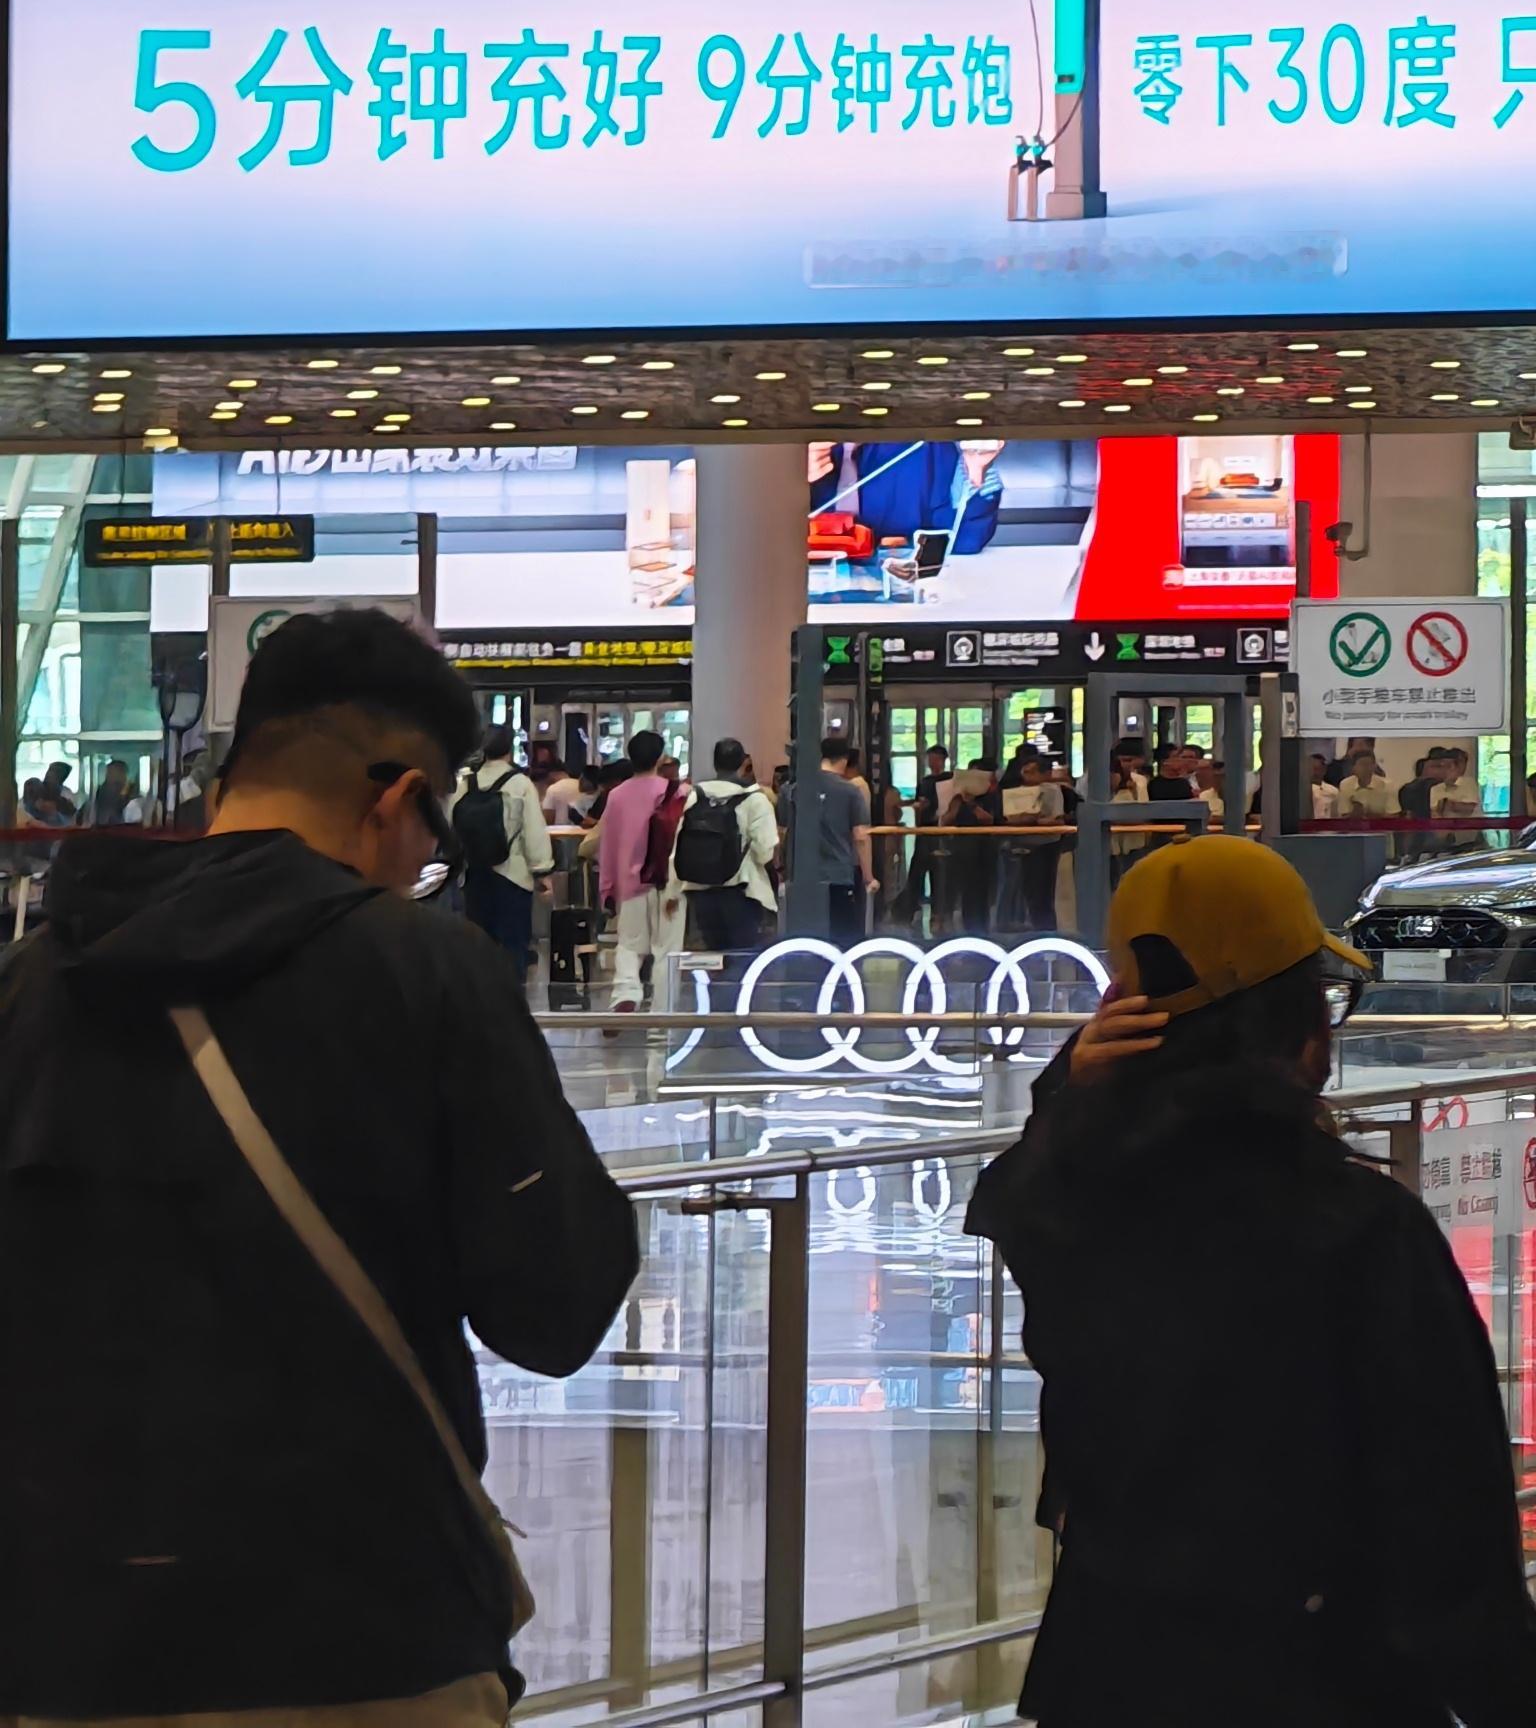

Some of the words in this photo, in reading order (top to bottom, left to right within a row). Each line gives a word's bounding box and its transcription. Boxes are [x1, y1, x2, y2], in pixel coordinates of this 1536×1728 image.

[130, 27, 663, 172] 5分钟充好
[697, 31, 1014, 138] 9分钟充饱
[1133, 15, 1456, 130] 零下30度
